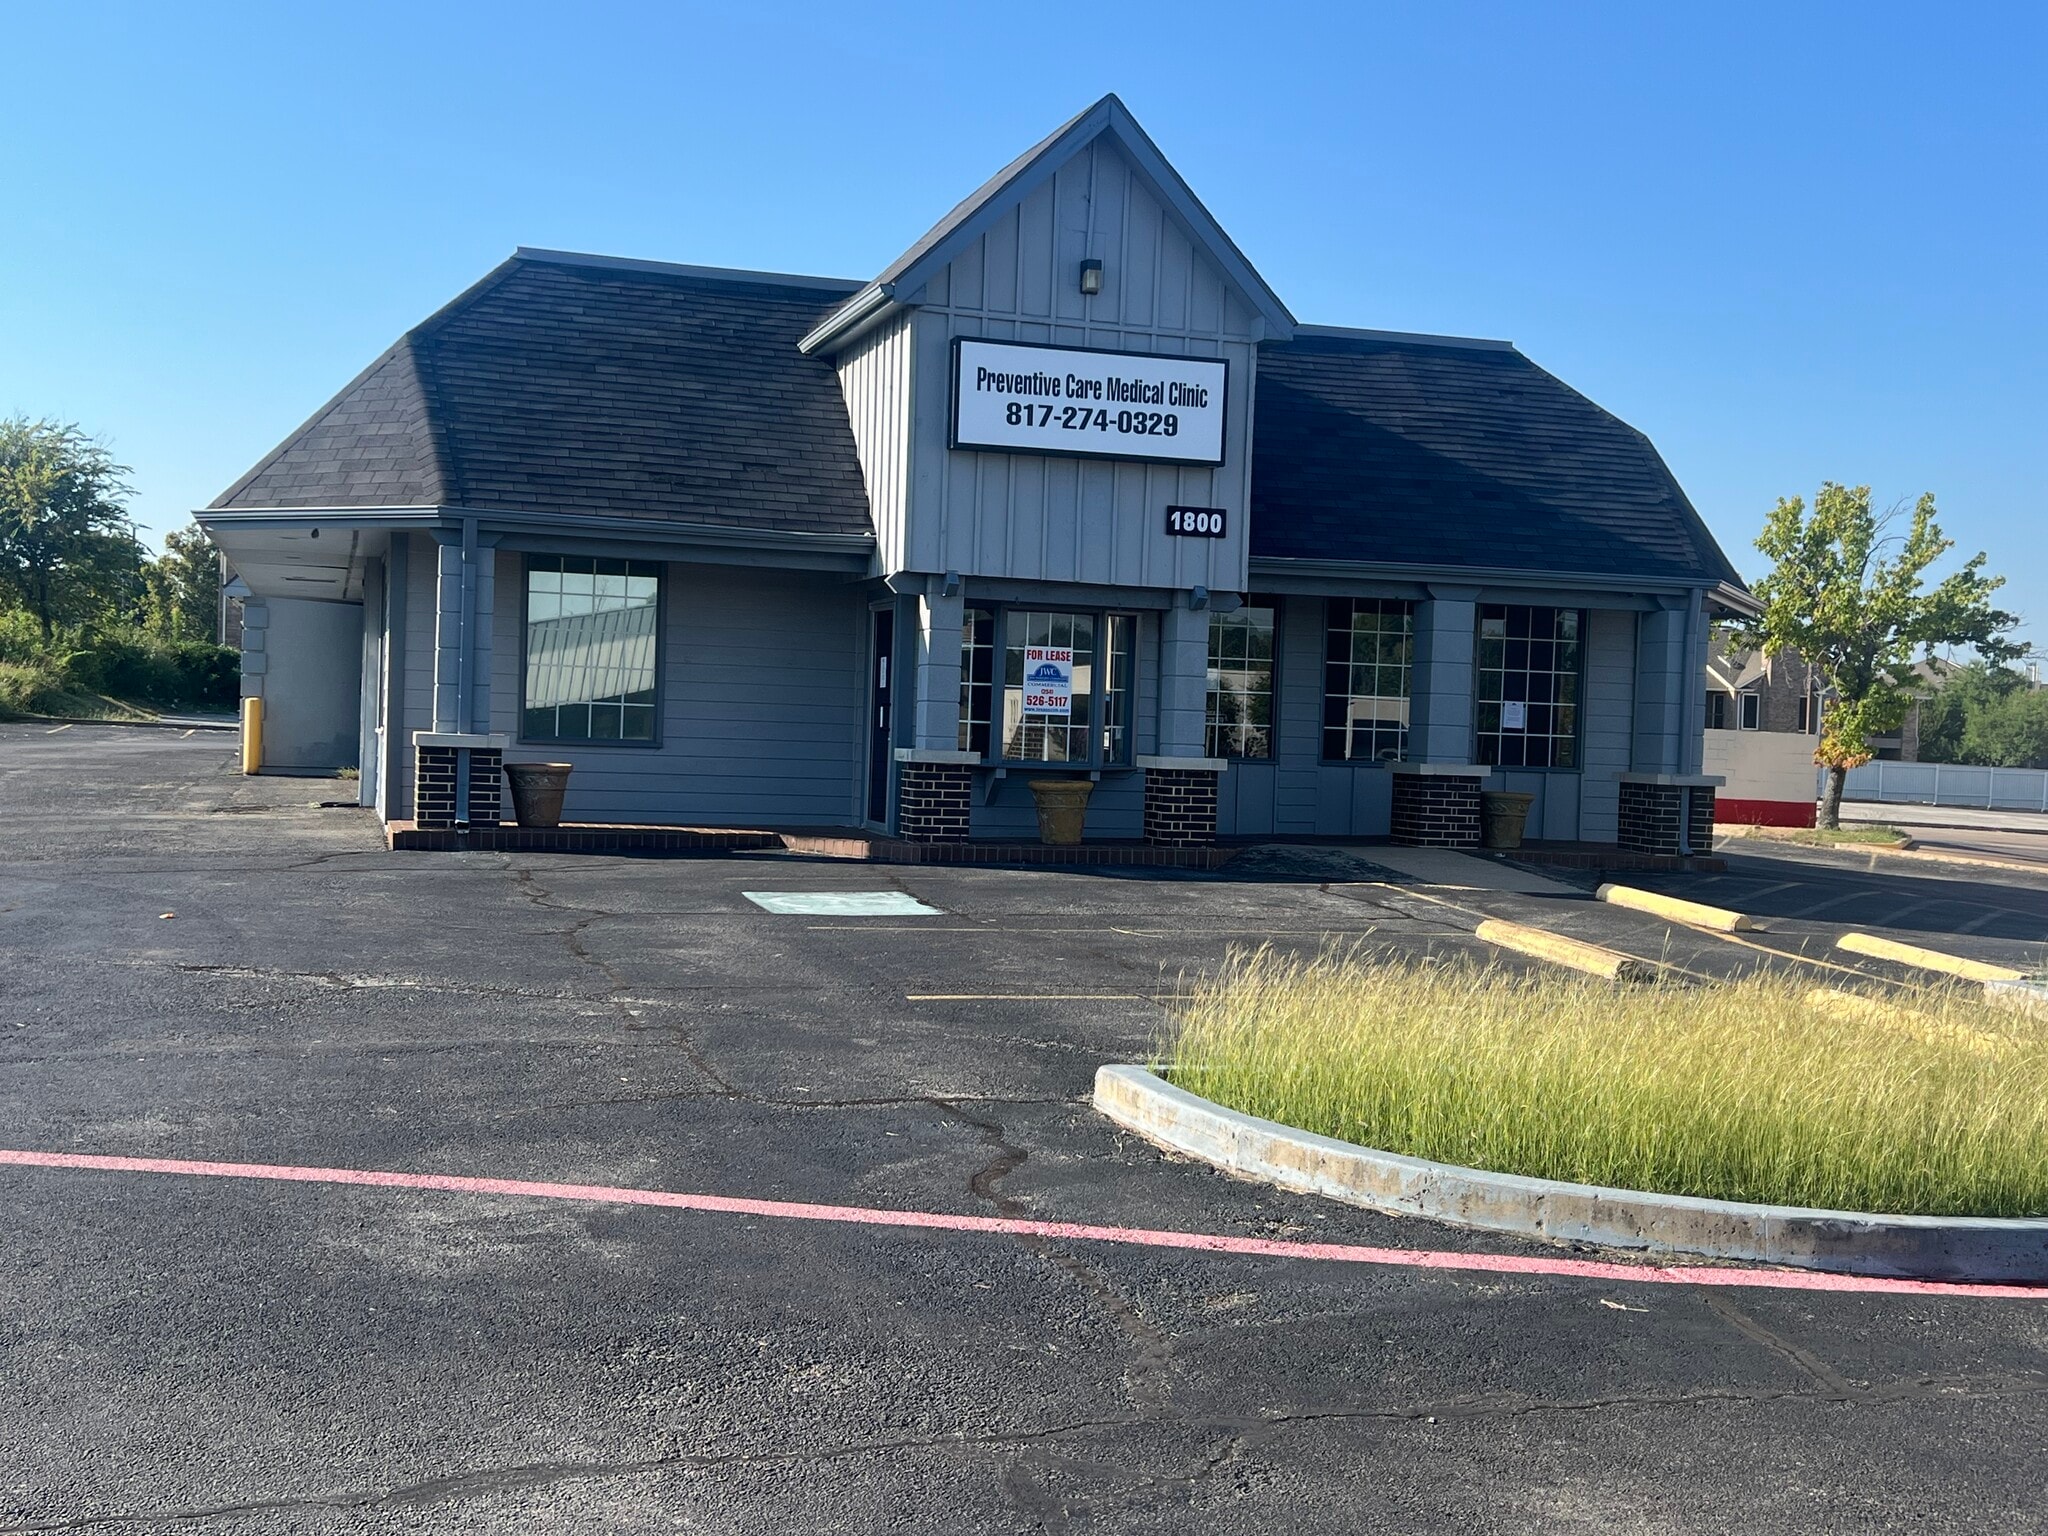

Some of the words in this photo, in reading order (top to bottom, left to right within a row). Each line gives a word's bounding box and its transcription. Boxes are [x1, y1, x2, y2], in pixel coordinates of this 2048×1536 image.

[977, 366, 1061, 397] Preventive
[1065, 373, 1102, 400] Care
[1106, 377, 1165, 406] Medical
[1168, 381, 1208, 408] Clinic
[1006, 402, 1179, 437] 817-274-0329
[1170, 511, 1222, 533] 1800
[1026, 649, 1043, 660] FOR
[1046, 650, 1071, 661] LEASE
[1039, 667, 1056, 676] JWC
[1026, 695, 1068, 707] 526-5117
